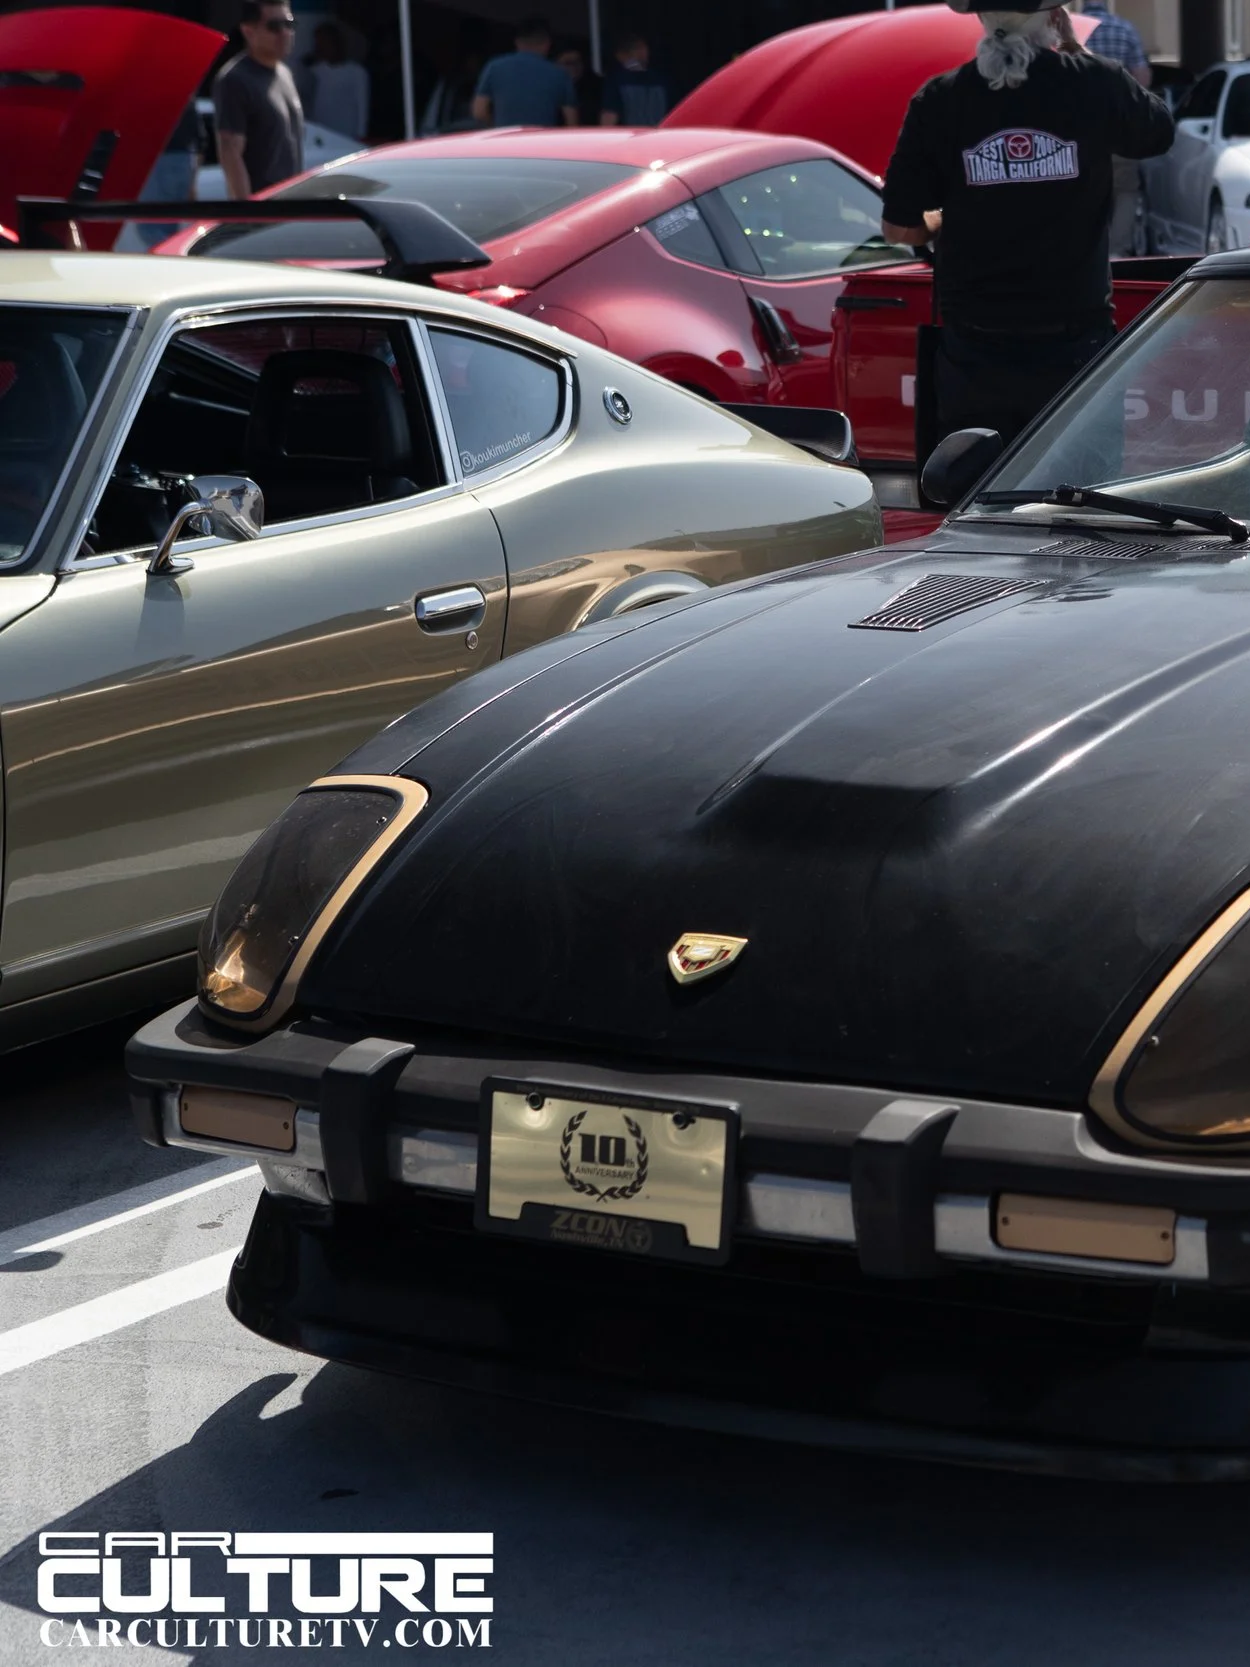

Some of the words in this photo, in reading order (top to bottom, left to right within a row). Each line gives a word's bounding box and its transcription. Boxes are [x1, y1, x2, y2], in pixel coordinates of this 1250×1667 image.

[981, 138, 1004, 161] EST
[967, 154, 1008, 182] TARGA
[1008, 146, 1075, 179] CALIFORNIA
[574, 1165, 635, 1180] ANNIVERSARY
[549, 1209, 628, 1239] ZCON
